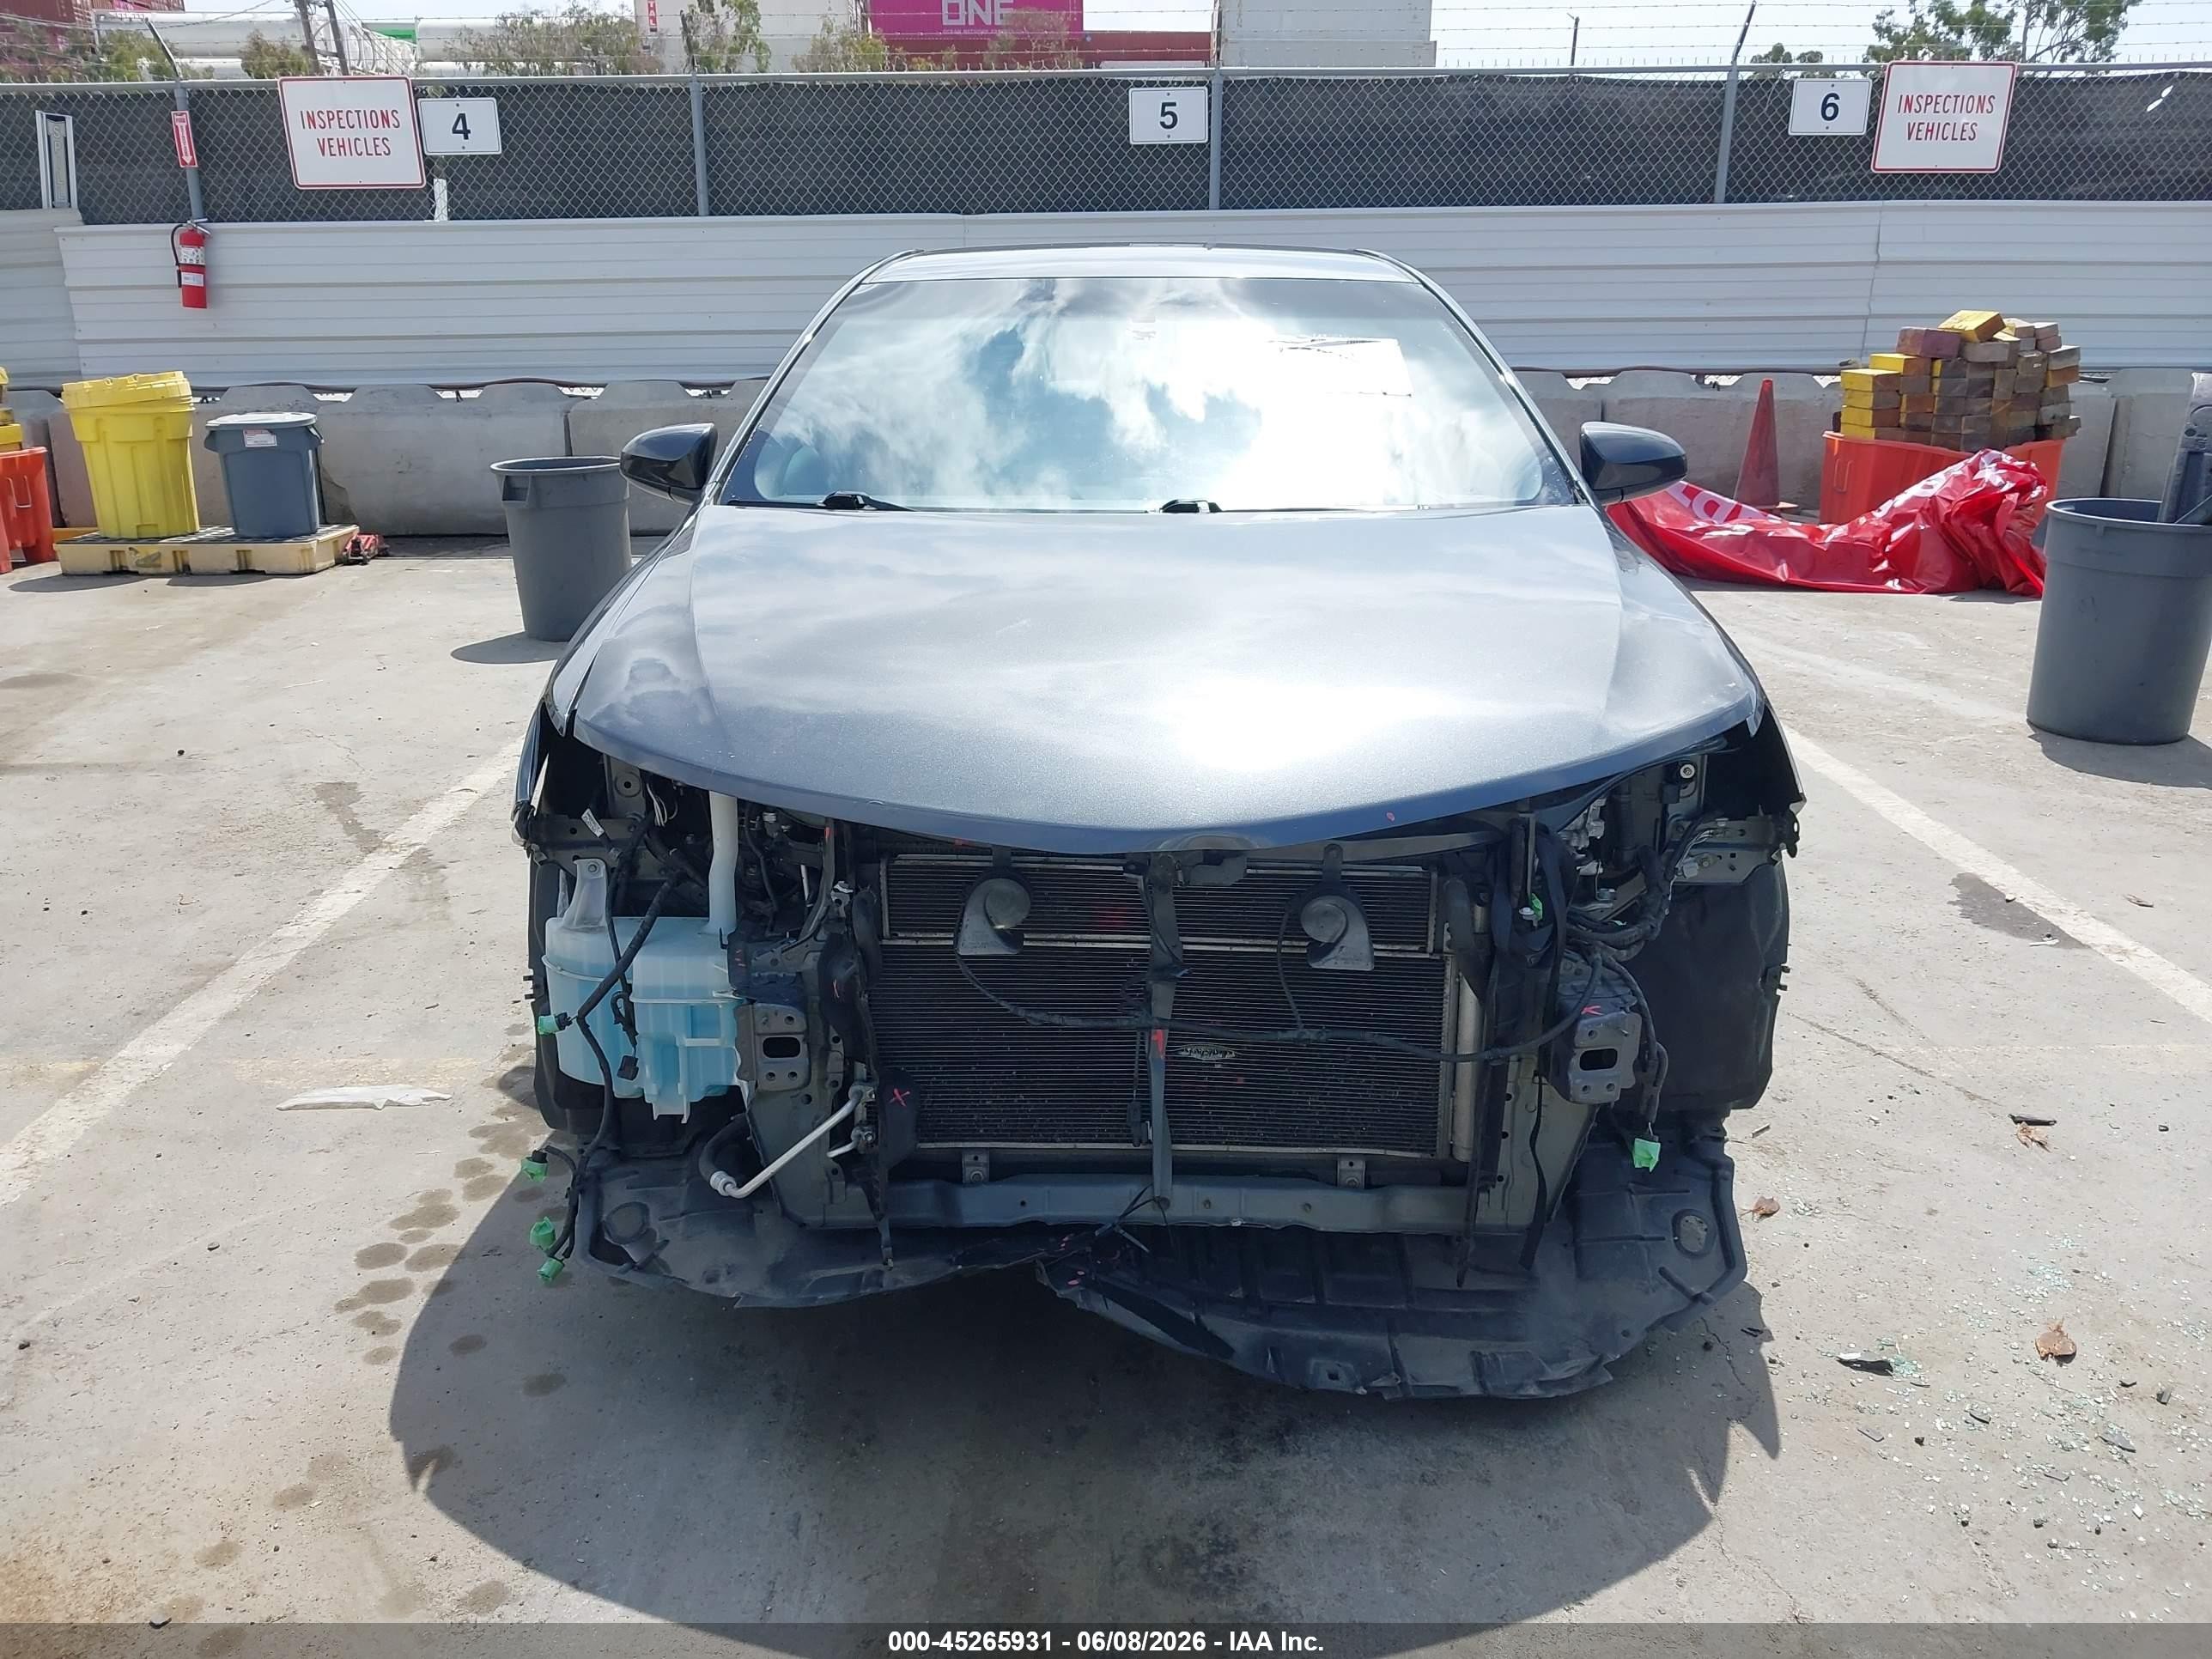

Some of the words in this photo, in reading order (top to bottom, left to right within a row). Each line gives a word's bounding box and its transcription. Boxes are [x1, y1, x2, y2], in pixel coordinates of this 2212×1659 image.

[943, 0, 1013, 26] ONE
[1159, 101, 1178, 130] 5
[1820, 92, 1840, 121] 6
[1897, 94, 1996, 114] INSPECTIONS
[301, 109, 401, 130] INSPECTIONS
[452, 112, 471, 140] 4
[1907, 121, 1978, 141] VEHICLES
[317, 137, 392, 156] VEHICLES
[53, 124, 67, 202] SPLL
